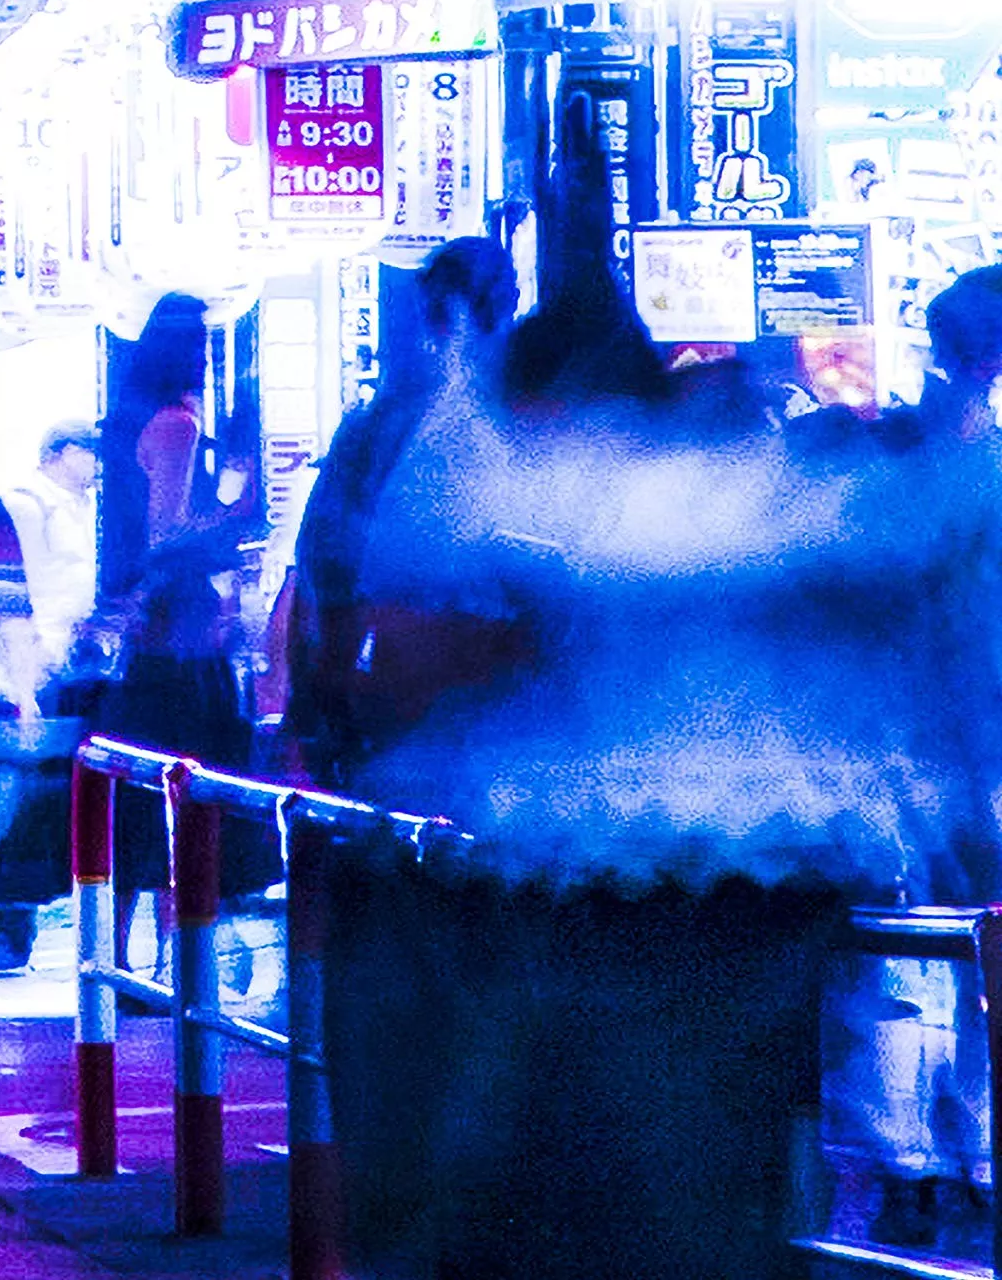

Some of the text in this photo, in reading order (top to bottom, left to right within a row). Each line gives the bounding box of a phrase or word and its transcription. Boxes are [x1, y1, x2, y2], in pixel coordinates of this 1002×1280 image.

[285, 75, 365, 107] 時間
[300, 121, 374, 147] 9:30
[712, 64, 788, 220] ゴール
[291, 166, 381, 194] 10:00
